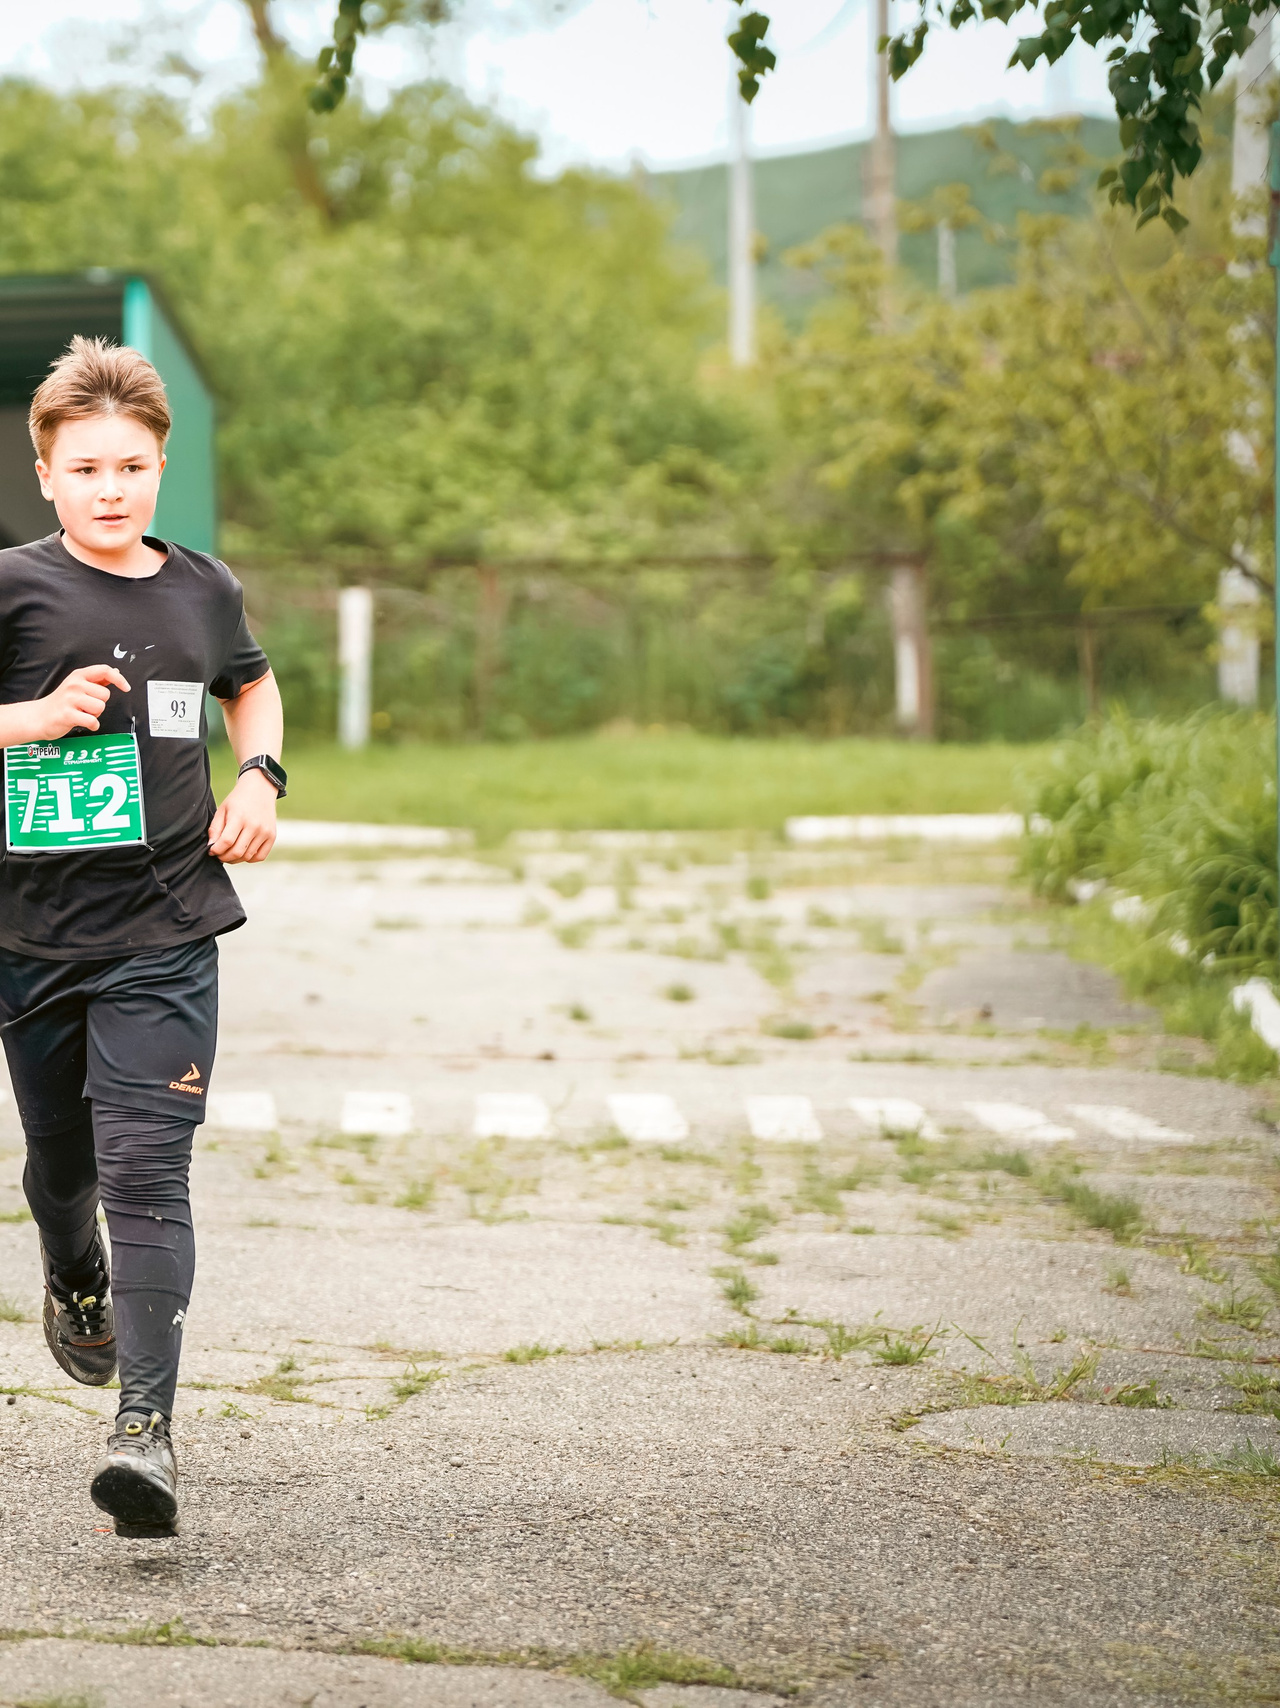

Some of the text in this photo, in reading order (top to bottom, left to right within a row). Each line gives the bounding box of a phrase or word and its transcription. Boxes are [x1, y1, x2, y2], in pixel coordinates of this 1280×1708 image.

[171, 700, 186, 718] 93
[17, 773, 131, 833] 712
[169, 1081, 204, 1095] DEMIX
